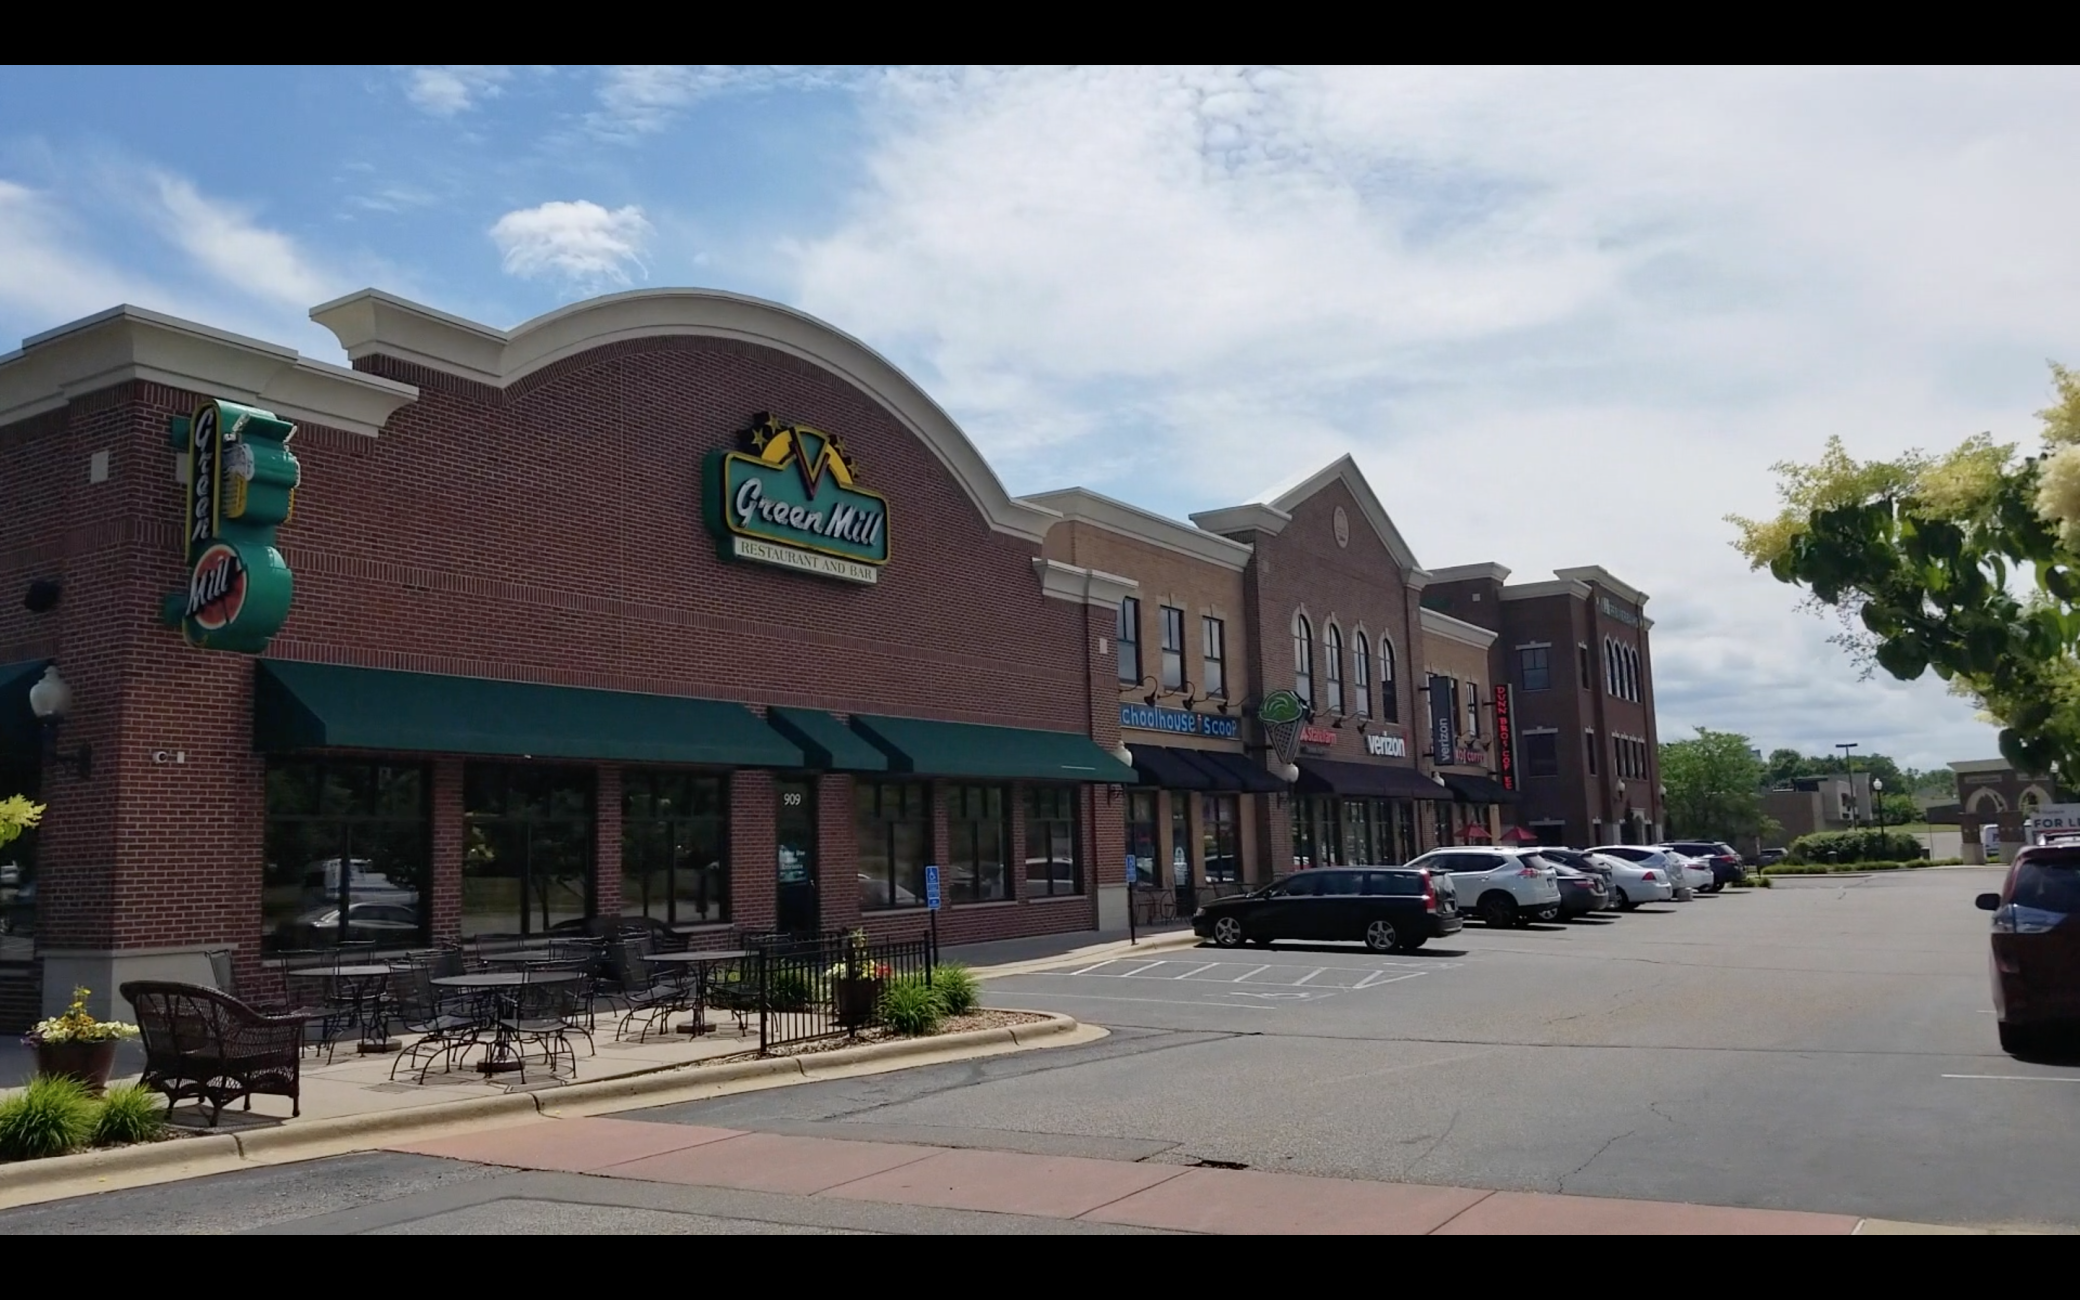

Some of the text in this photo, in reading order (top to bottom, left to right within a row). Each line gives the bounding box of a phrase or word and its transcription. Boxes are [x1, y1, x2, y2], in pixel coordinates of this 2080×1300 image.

[192, 408, 213, 541] Green
[736, 477, 884, 545] Green Mill
[741, 541, 872, 580] RESTAURANT AND BAR
[185, 556, 230, 615] Mill
[1122, 704, 1196, 732] choolhouse
[1367, 730, 1406, 757] verizon
[1438, 717, 1450, 761] verizon
[1502, 750, 1512, 790] COFEE
[783, 793, 801, 806] 909
[2034, 818, 2063, 828] FOR
